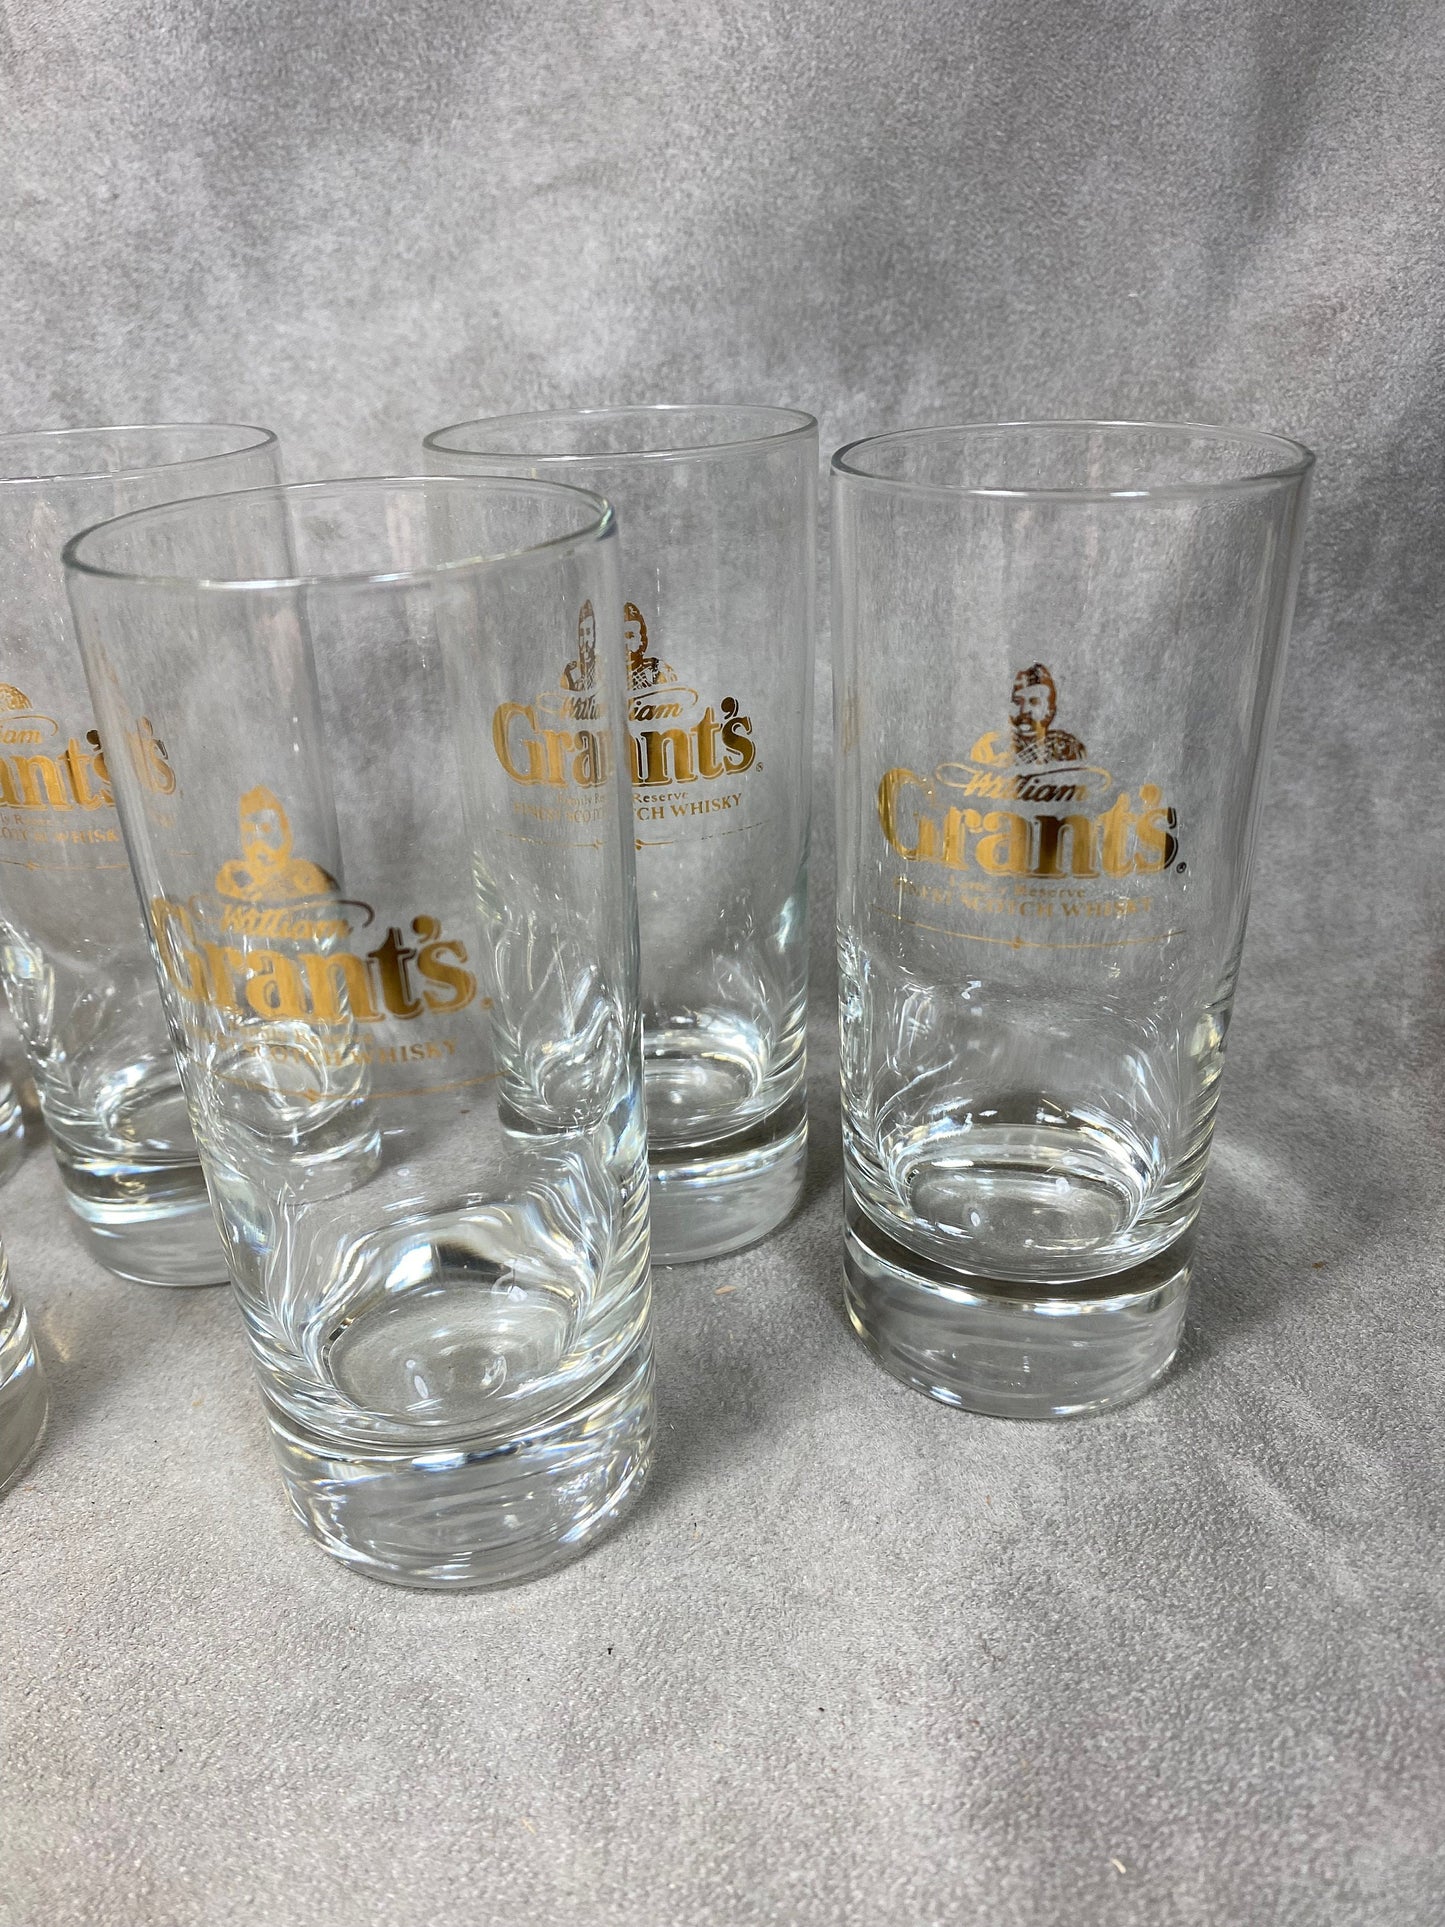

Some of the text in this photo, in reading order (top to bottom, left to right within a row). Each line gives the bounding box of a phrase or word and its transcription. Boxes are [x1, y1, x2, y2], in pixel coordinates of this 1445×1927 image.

[492, 696, 757, 789] Grant's
[671, 792, 743, 818] WHISKY
[877, 767, 1178, 881] Grant's
[151, 896, 479, 1027] Grant's
